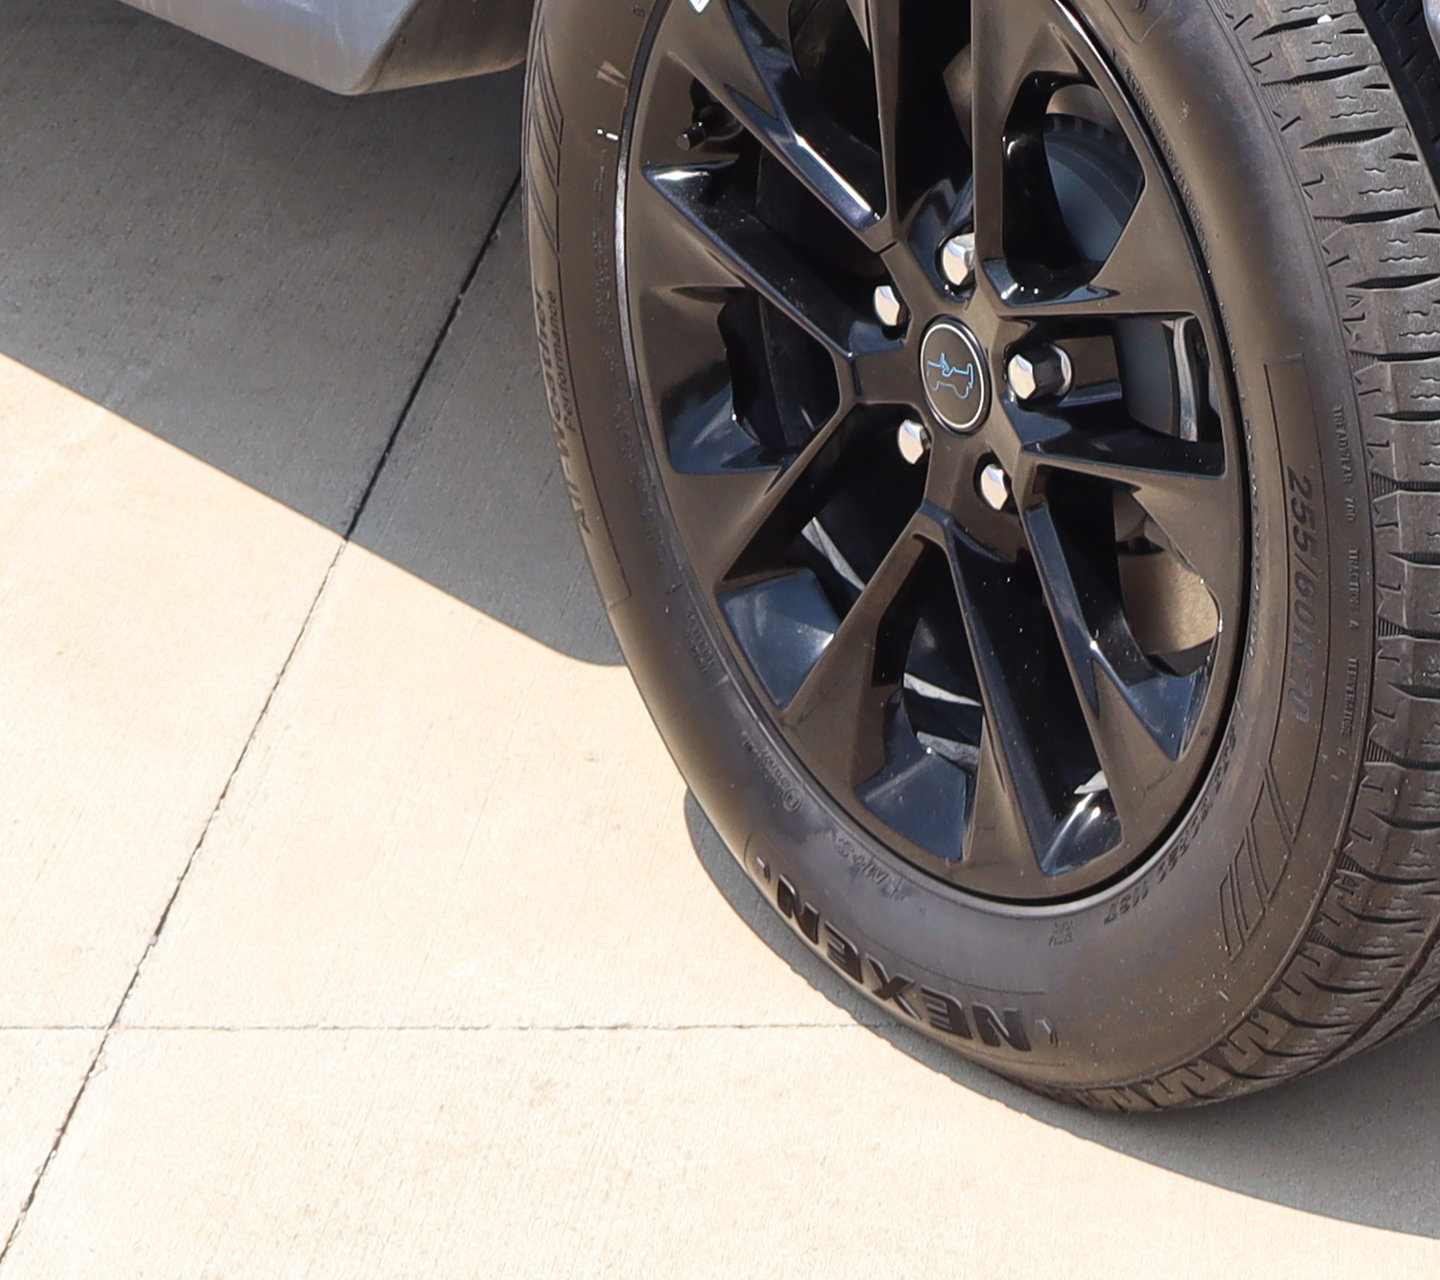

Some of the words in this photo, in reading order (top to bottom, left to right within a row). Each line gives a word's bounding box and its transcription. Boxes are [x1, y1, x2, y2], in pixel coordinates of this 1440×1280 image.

[546, 290, 577, 435] Performance
[1345, 494, 1356, 521] 700
[1287, 464, 1321, 725] 255/60R20
[776, 873, 1033, 1052] NEXEN
